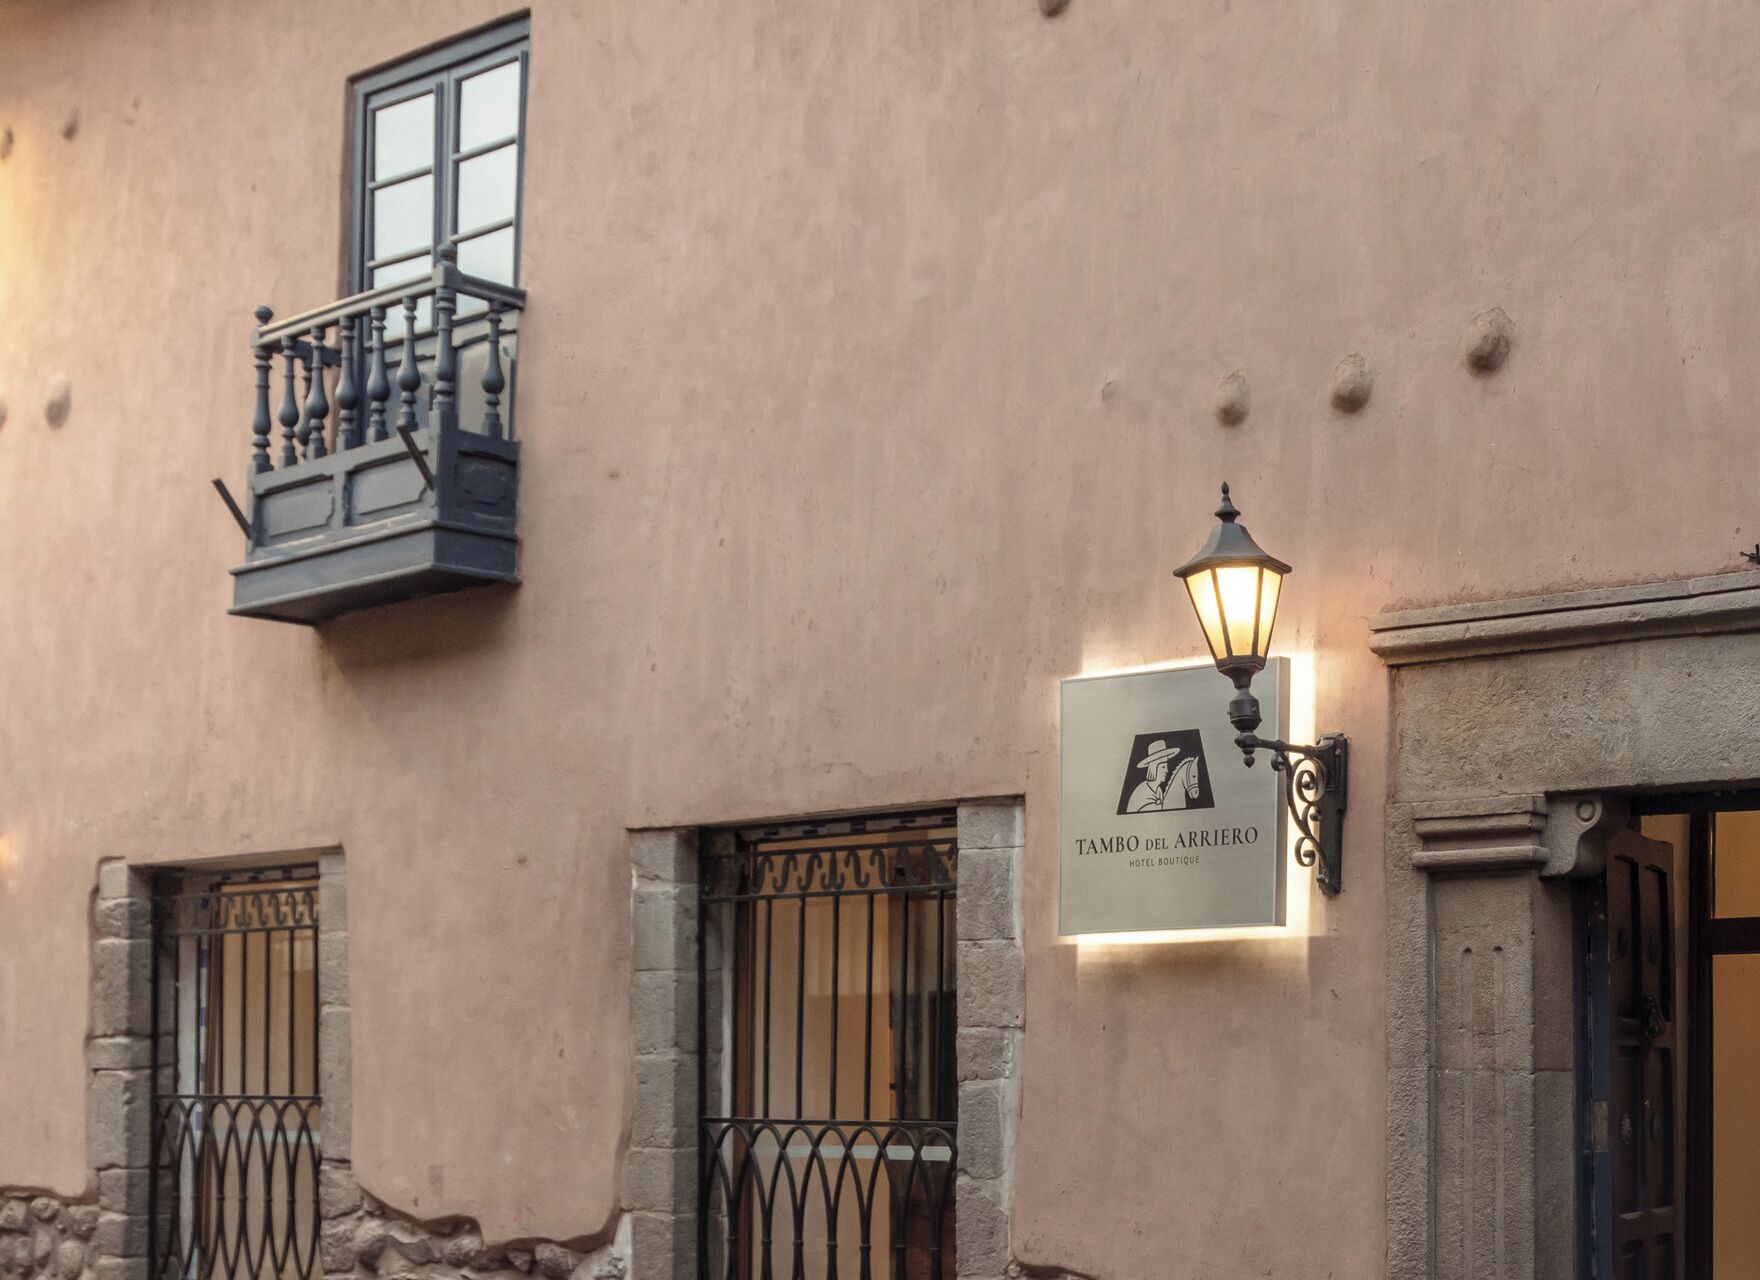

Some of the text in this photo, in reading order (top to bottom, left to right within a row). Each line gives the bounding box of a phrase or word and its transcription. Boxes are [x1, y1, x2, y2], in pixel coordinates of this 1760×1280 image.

[1075, 826, 1259, 856] TAMBO DEL ARRIERO
[1129, 855, 1200, 868] HOTEL BOUTIQUE
